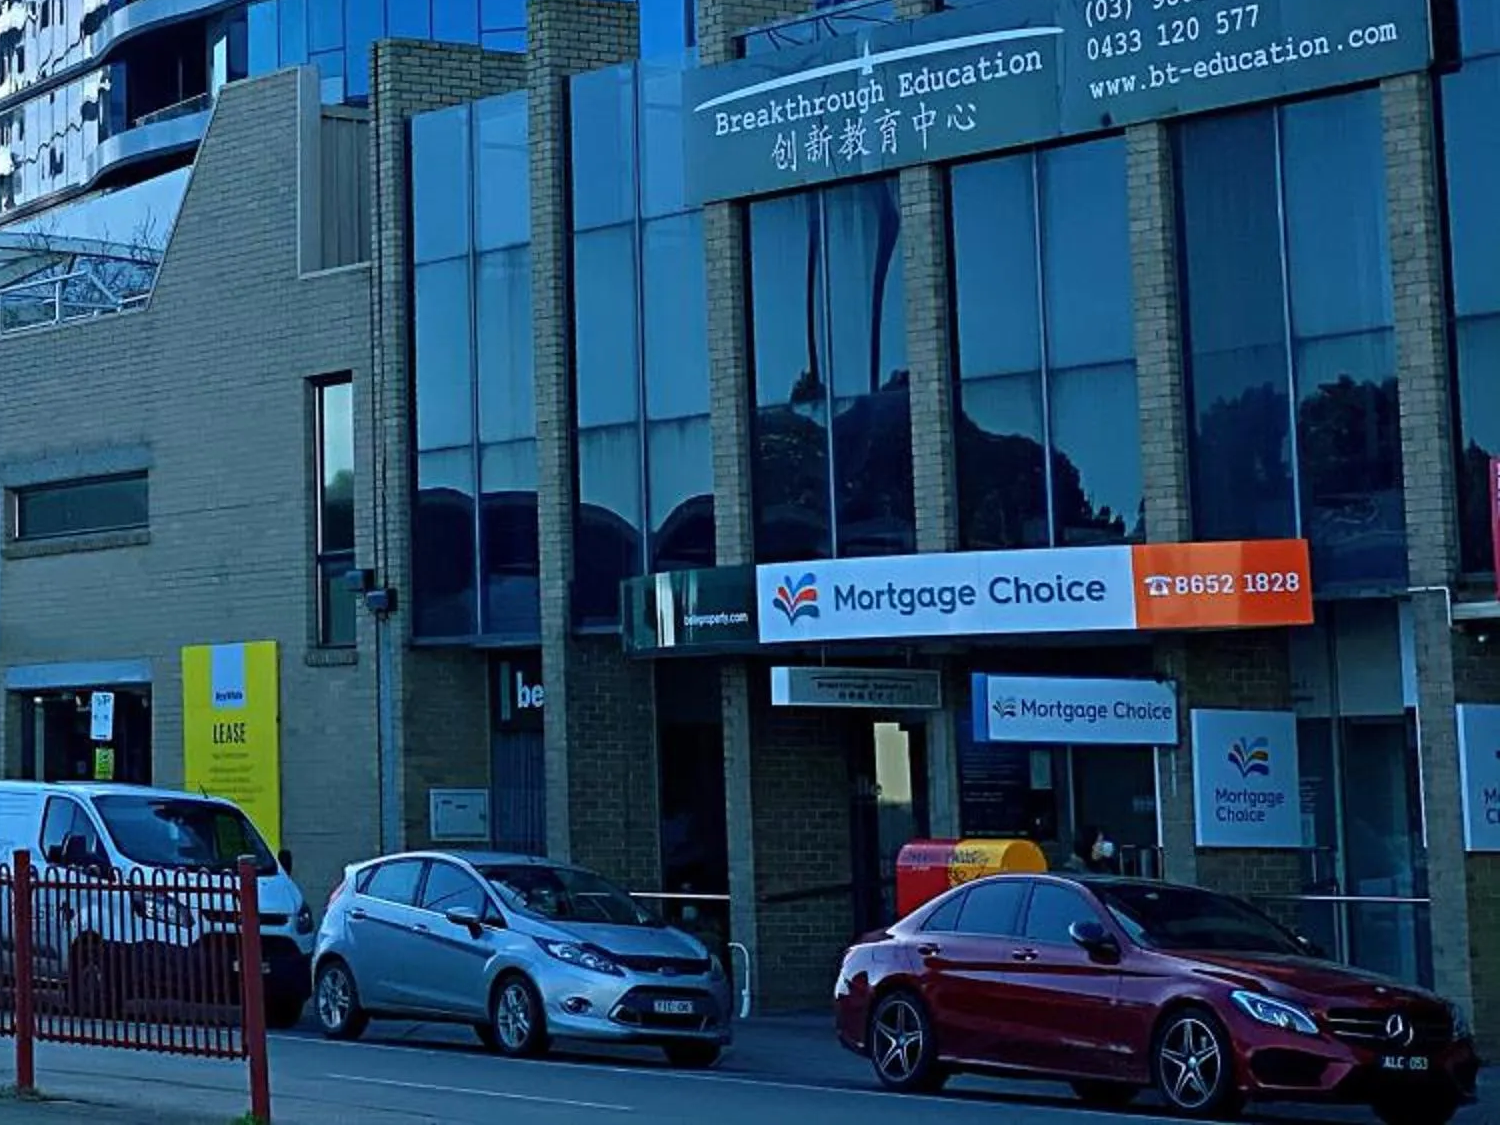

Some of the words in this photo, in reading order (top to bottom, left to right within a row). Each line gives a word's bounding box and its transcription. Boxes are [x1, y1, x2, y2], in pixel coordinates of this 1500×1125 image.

[1087, 29, 1142, 61] 0433
[1156, 16, 1200, 47] 120
[1216, 4, 1260, 35] 577
[1089, 22, 1397, 99] www.bt-education.com
[714, 79, 885, 136] Breakthrough
[899, 48, 1043, 99] Education
[771, 101, 978, 172] 创新教育中心
[833, 582, 976, 616] Mortgage
[988, 574, 1106, 604] Choice
[1174, 573, 1236, 595] 8652
[1243, 572, 1300, 593] 1828
[1020, 698, 1109, 723] Mortgage
[1113, 701, 1173, 720] Choice
[213, 722, 246, 744] LEASE
[1215, 787, 1285, 809] Mortgage
[1215, 806, 1266, 823] Choice
